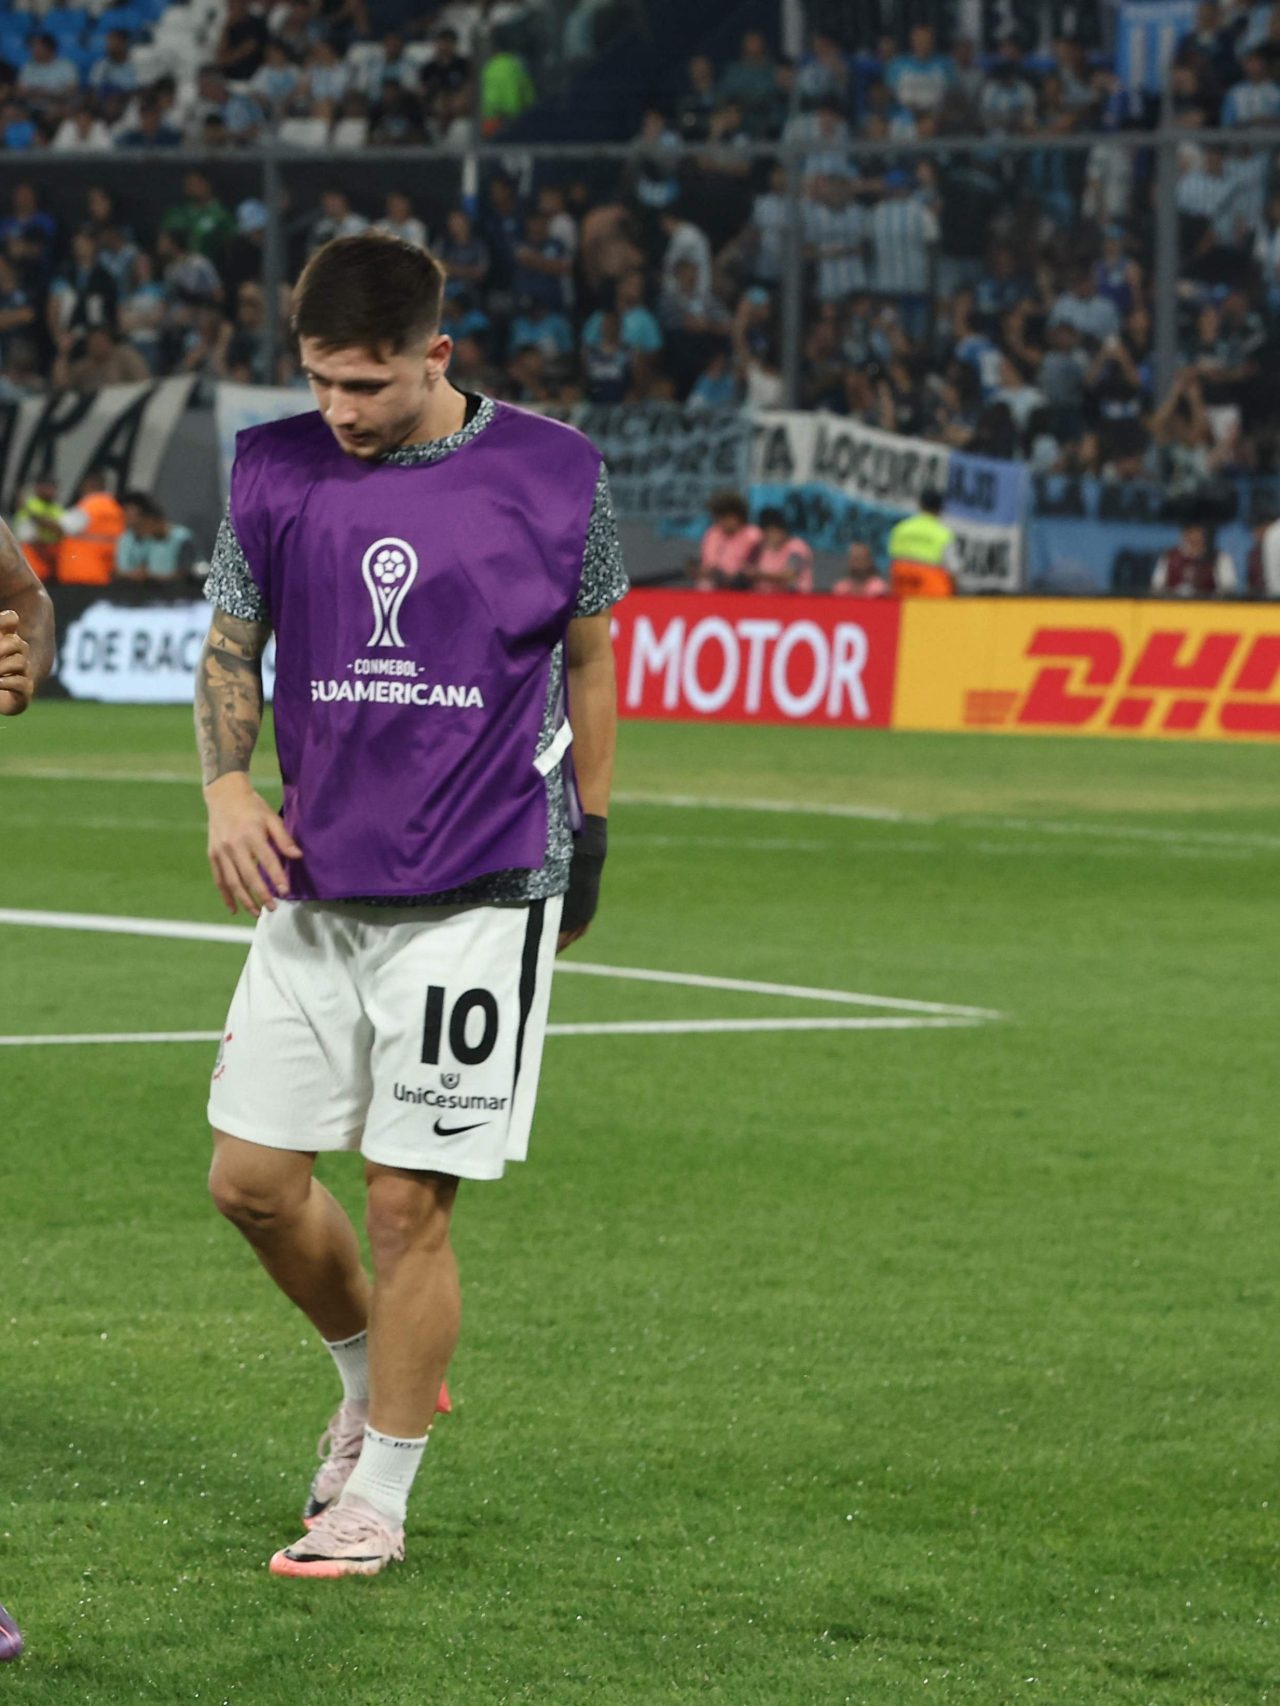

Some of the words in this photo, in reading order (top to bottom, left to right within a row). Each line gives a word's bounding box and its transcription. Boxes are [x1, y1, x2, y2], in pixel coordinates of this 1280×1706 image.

[354, 658, 418, 677] CONMEBOL
[626, 615, 870, 720] MOTOR
[421, 985, 499, 1065] 10
[394, 1082, 508, 1110] UniCesumar
